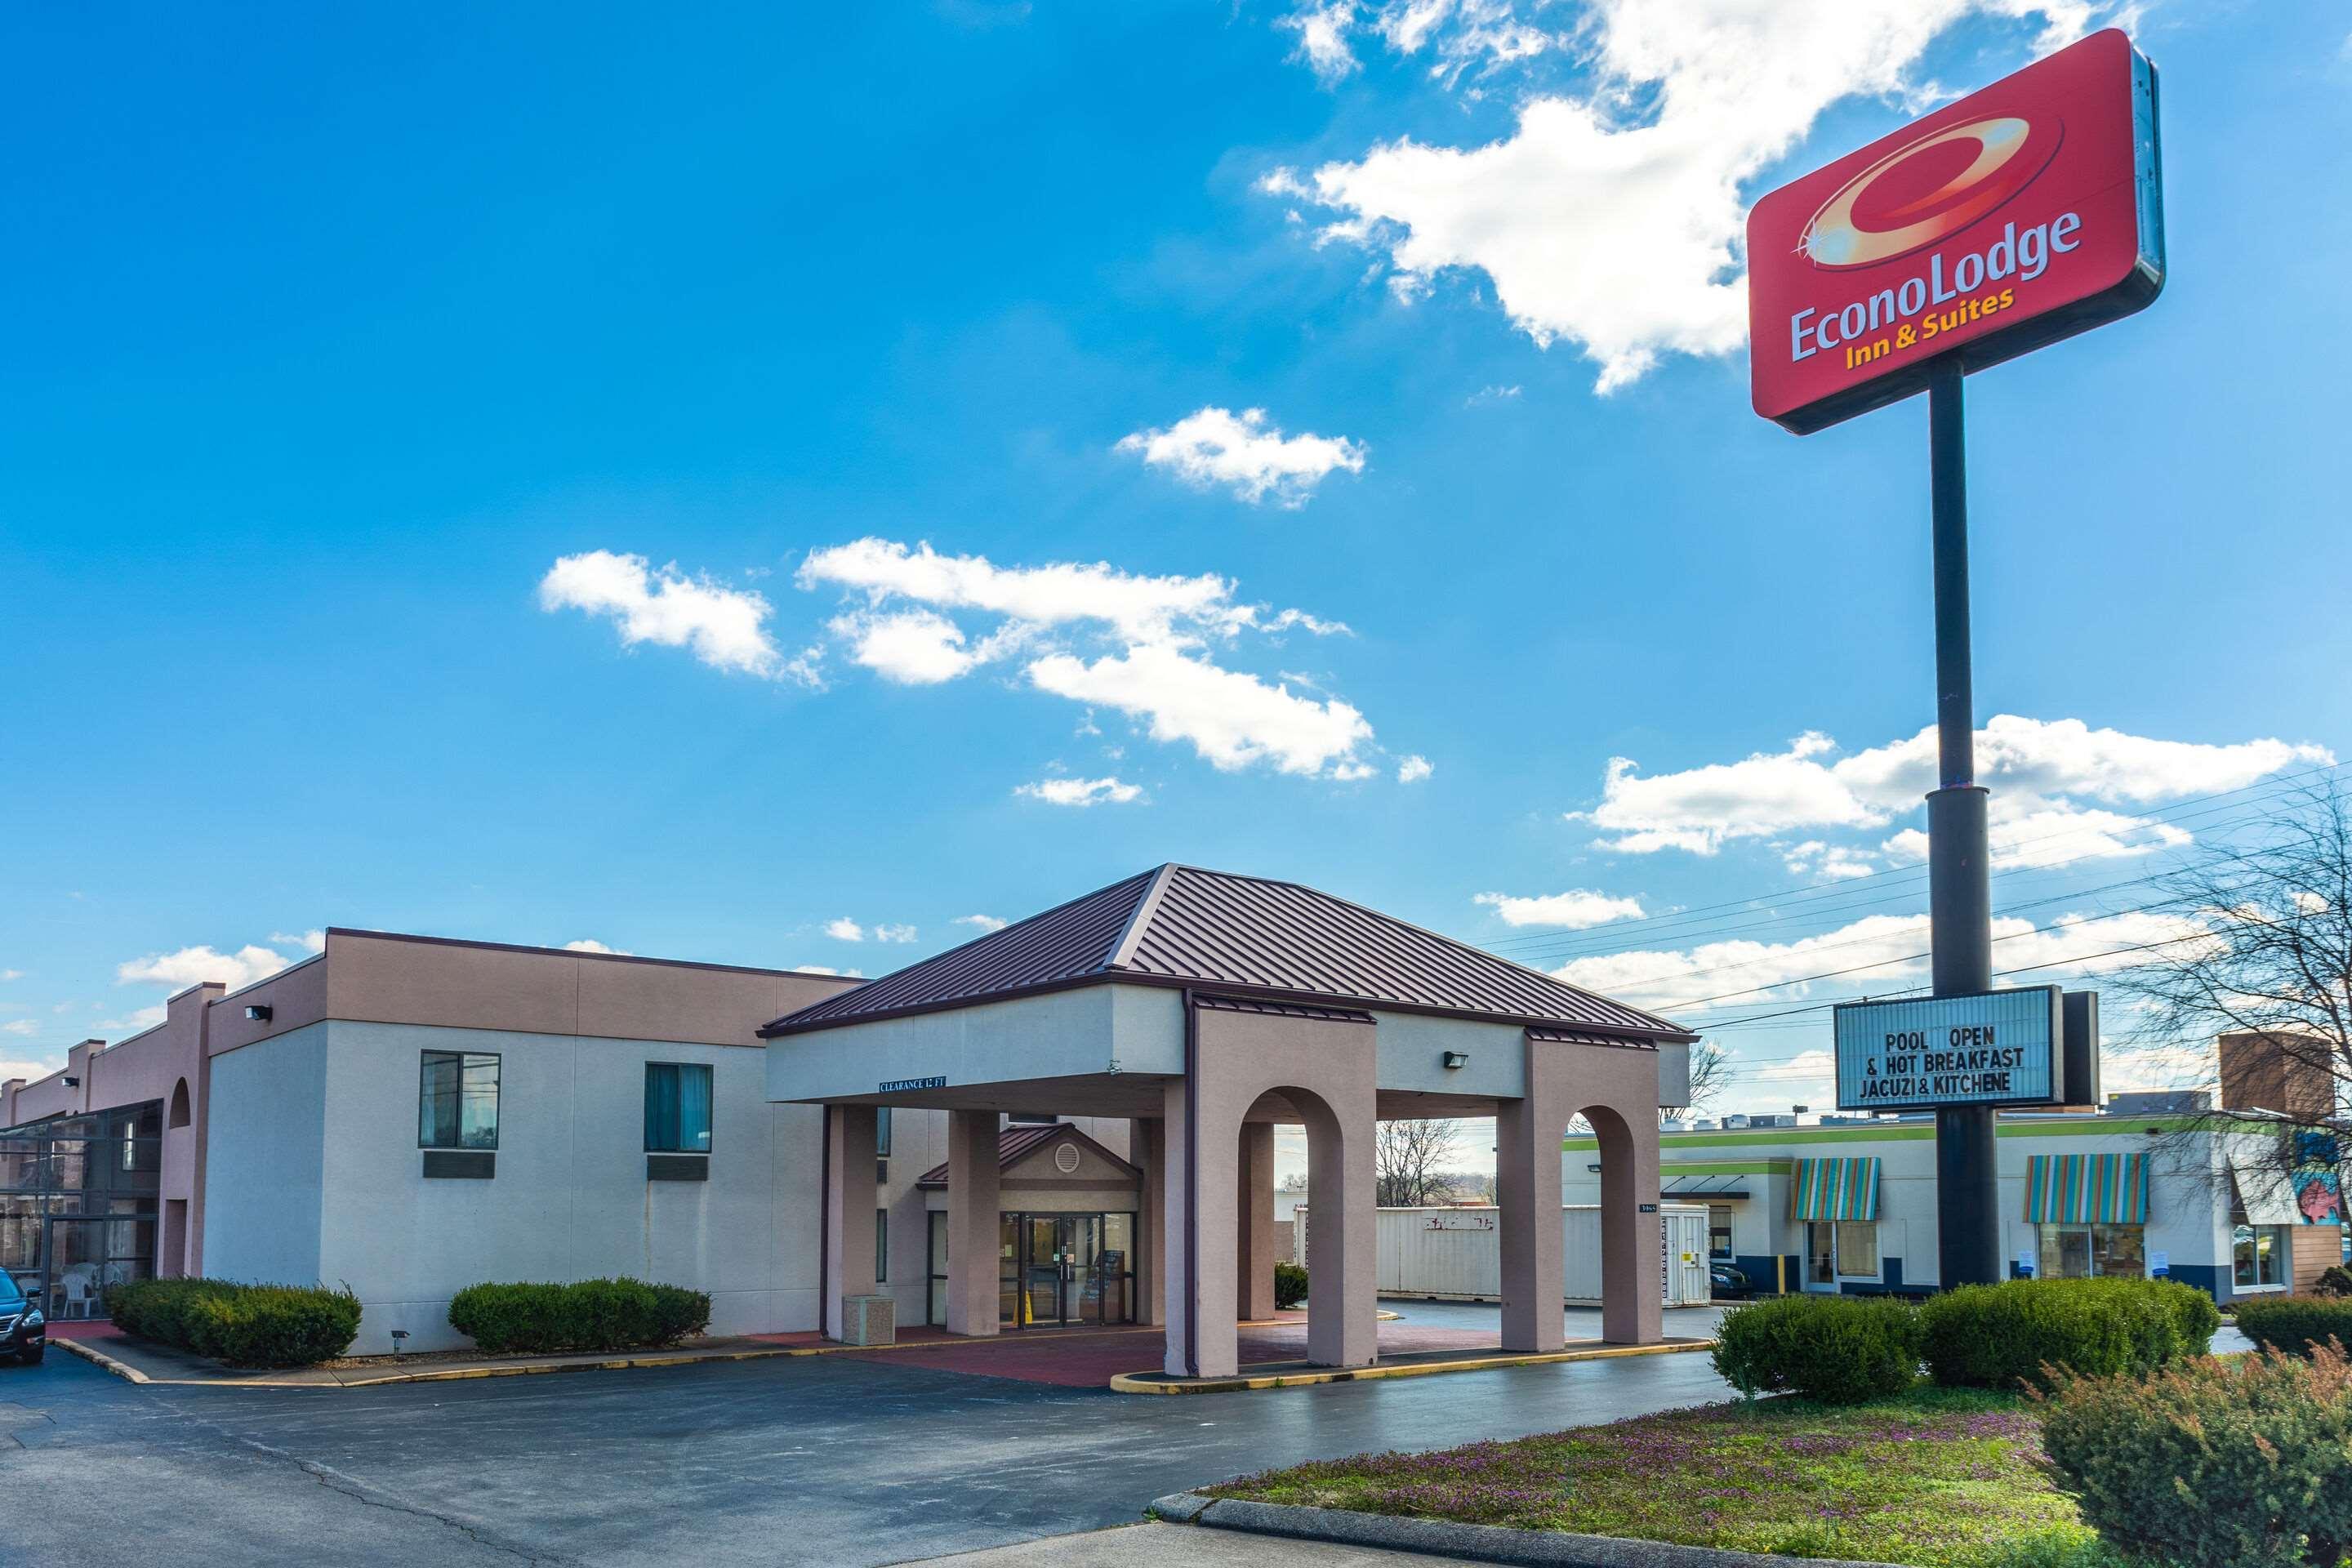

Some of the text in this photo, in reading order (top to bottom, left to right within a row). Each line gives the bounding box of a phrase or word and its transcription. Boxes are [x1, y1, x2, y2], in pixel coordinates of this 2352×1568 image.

[1846, 288, 2015, 370] Inn & Suites
[1886, 1026, 1994, 1052] POOL OPEN
[1867, 1048, 2024, 1076] & HOT BREAKFAST
[880, 1079, 924, 1092] CLEARANCE
[1860, 1072, 2011, 1098] JACUZI & KITCHENE
